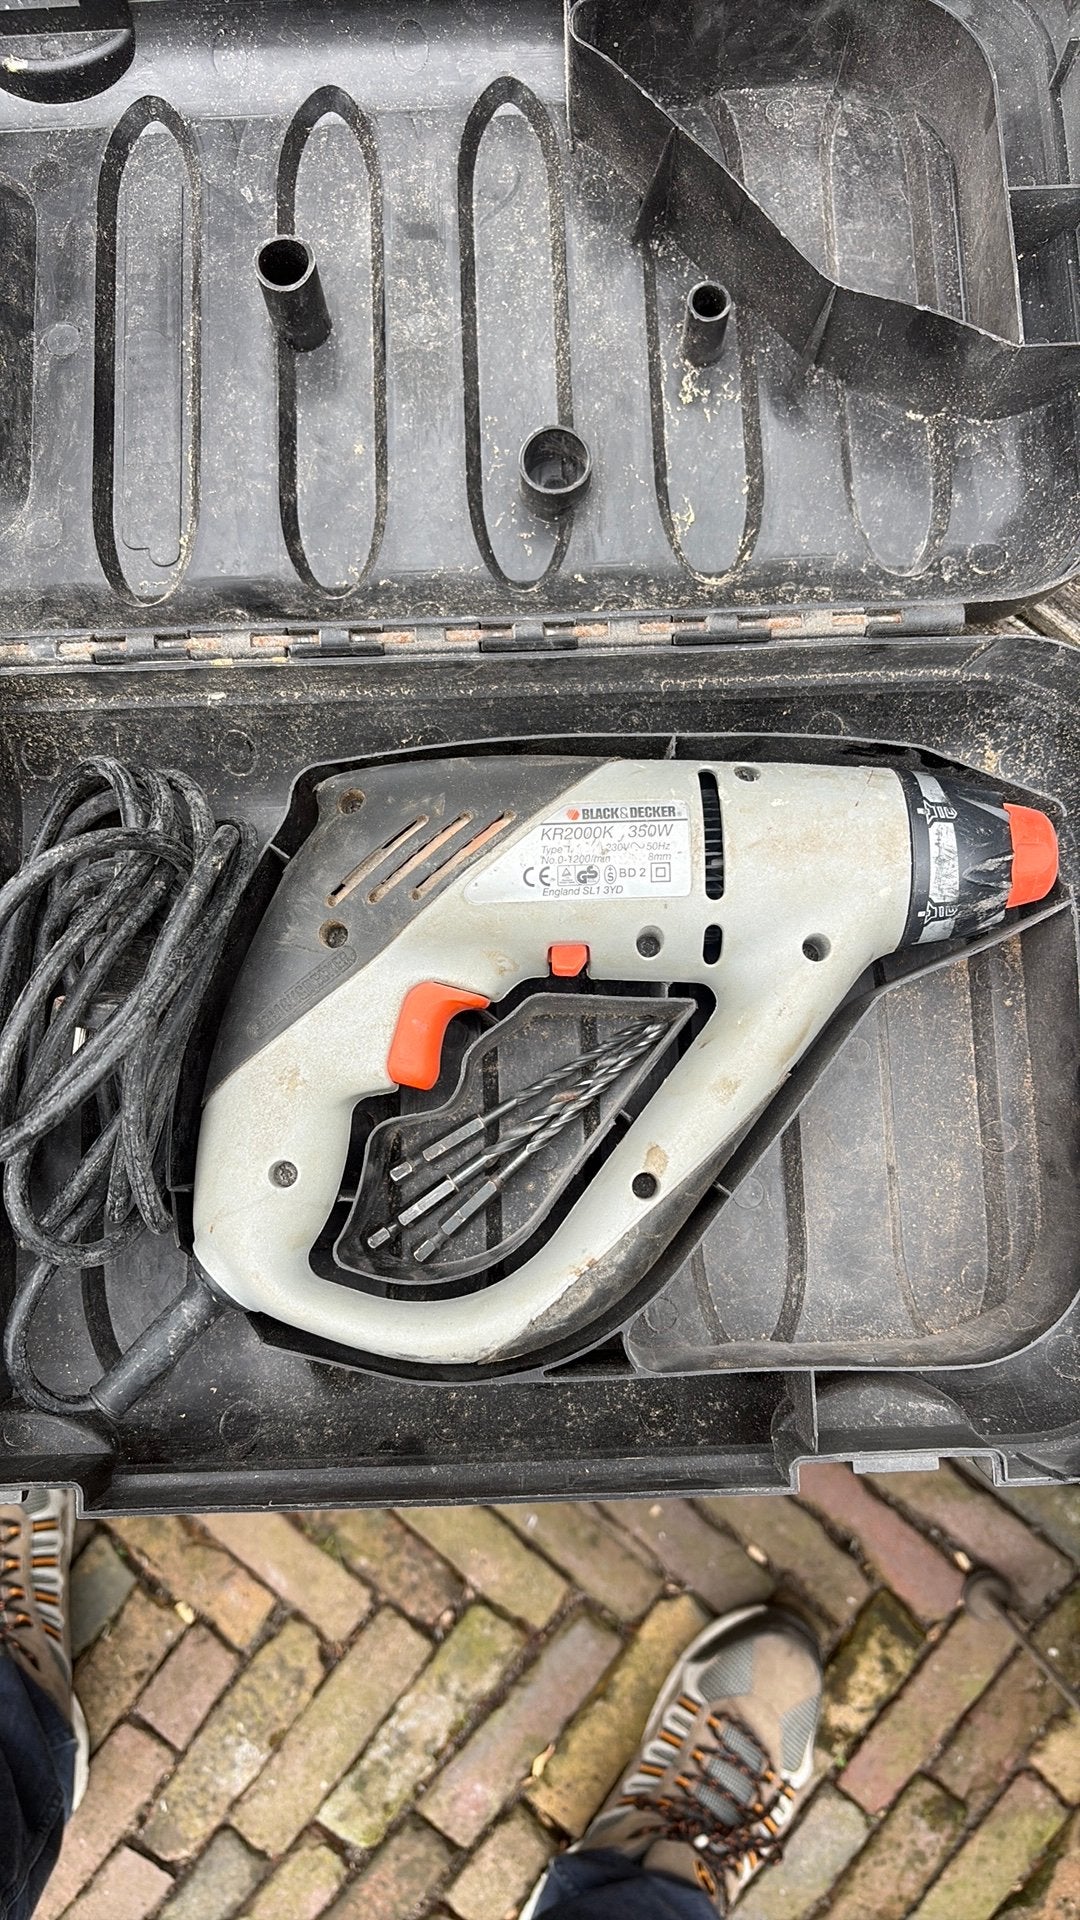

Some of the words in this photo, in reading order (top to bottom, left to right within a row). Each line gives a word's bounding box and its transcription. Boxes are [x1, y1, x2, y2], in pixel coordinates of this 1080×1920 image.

[582, 806, 676, 820] BLACK&DECKER
[541, 825, 614, 841] KR2000K
[628, 823, 674, 838] 350W
[541, 845, 563, 856] Type
[647, 852, 672, 861] 8mm
[542, 887, 580, 898] England
[582, 886, 600, 896] SL1
[603, 885, 624, 895] 3YD
